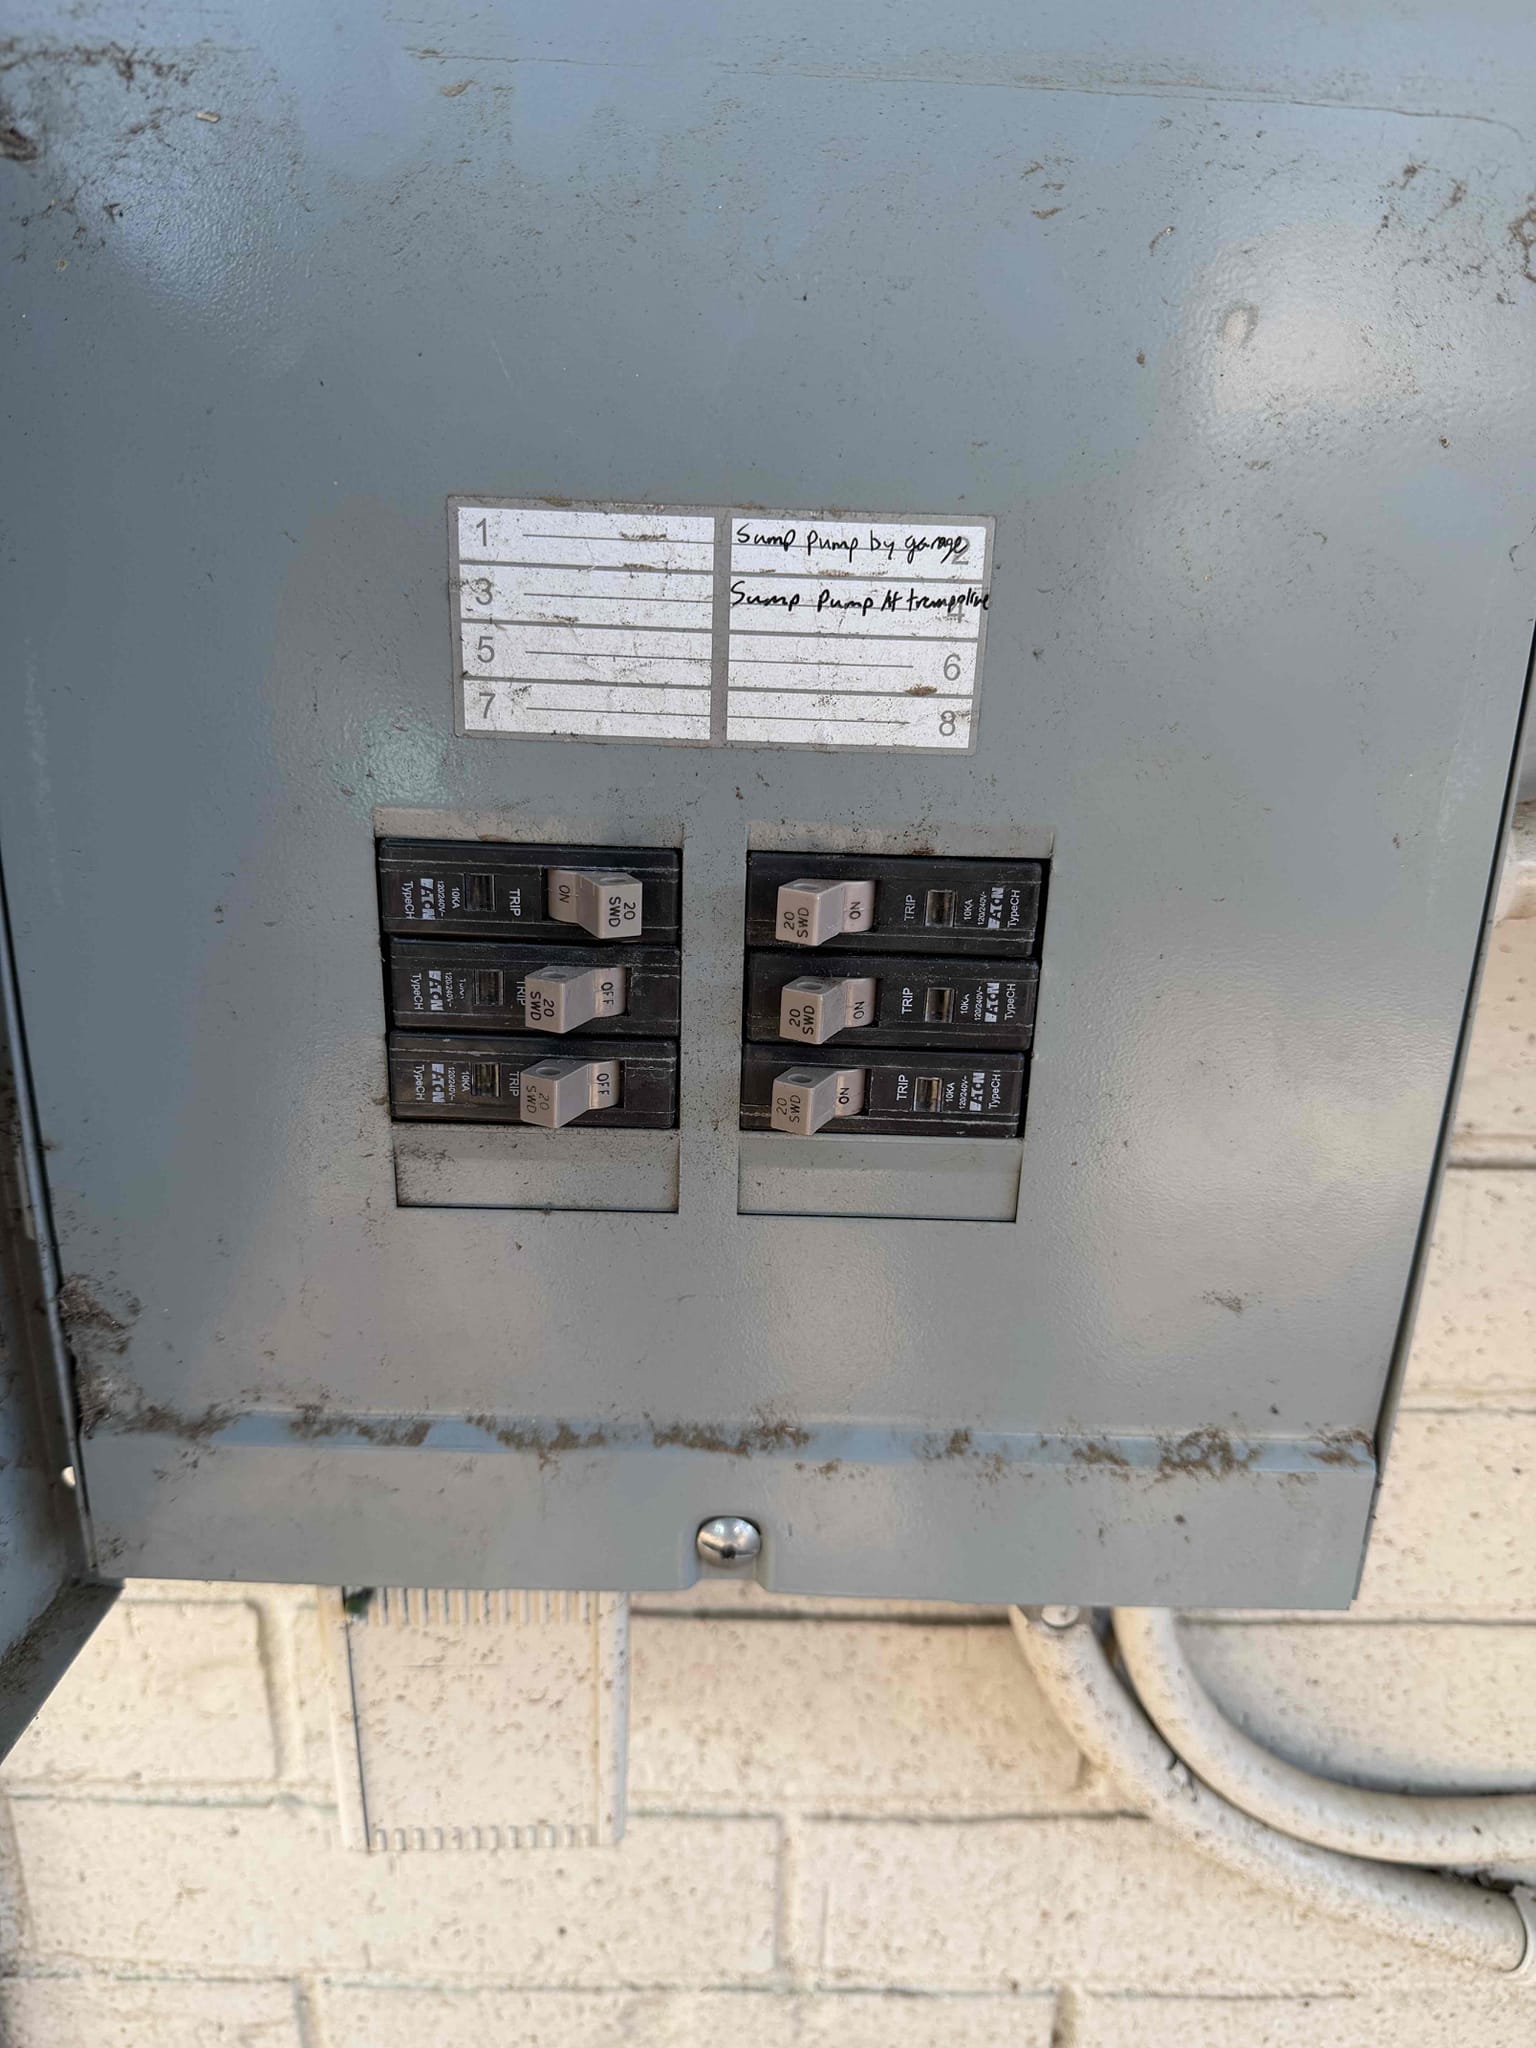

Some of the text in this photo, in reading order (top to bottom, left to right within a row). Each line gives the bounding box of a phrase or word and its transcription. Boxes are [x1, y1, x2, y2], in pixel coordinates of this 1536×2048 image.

[475, 517, 488, 547] 1
[736, 522, 797, 552] Sump
[869, 529, 896, 561] by
[904, 534, 968, 564] garage
[475, 577, 494, 606] 3
[729, 580, 802, 612] Sump
[476, 635, 496, 664] 5
[943, 652, 962, 682] 6
[478, 691, 497, 720] 7
[938, 710, 957, 737] 8
[420, 878, 437, 921] EATON
[451, 887, 461, 909] 10KA
[509, 888, 521, 917] TRIP
[559, 884, 571, 903] ON
[608, 896, 621, 928] SWD
[623, 901, 636, 920] 20
[783, 911, 795, 931] 20
[850, 901, 862, 920] ON
[904, 894, 916, 921] TRIP
[963, 899, 974, 921] 10KA
[988, 887, 1005, 929] EATON
[797, 907, 809, 939] SWD
[429, 970, 444, 1012] EATON
[516, 981, 526, 1006] TRIP
[600, 981, 614, 1006] OFF
[902, 987, 914, 1015] TRIP
[985, 982, 1000, 1024] EATON
[530, 991, 542, 1021] SWD
[543, 998, 555, 1018] 20
[789, 1009, 801, 1028] 20
[853, 1001, 865, 1020] ON
[802, 1005, 815, 1036] SWD
[432, 1063, 446, 1103] EATON
[462, 1071, 470, 1092] 10KA
[508, 1071, 520, 1097] TRIP
[596, 1073, 610, 1096] OFF
[896, 1074, 909, 1101] TRIP
[945, 1082, 955, 1103] 10KA
[969, 1071, 985, 1112] EATON
[526, 1085, 537, 1114] SWD
[538, 1094, 550, 1111] 20
[776, 1097, 788, 1116] 20
[789, 1094, 801, 1123] SWD
[838, 1086, 850, 1105] ON
